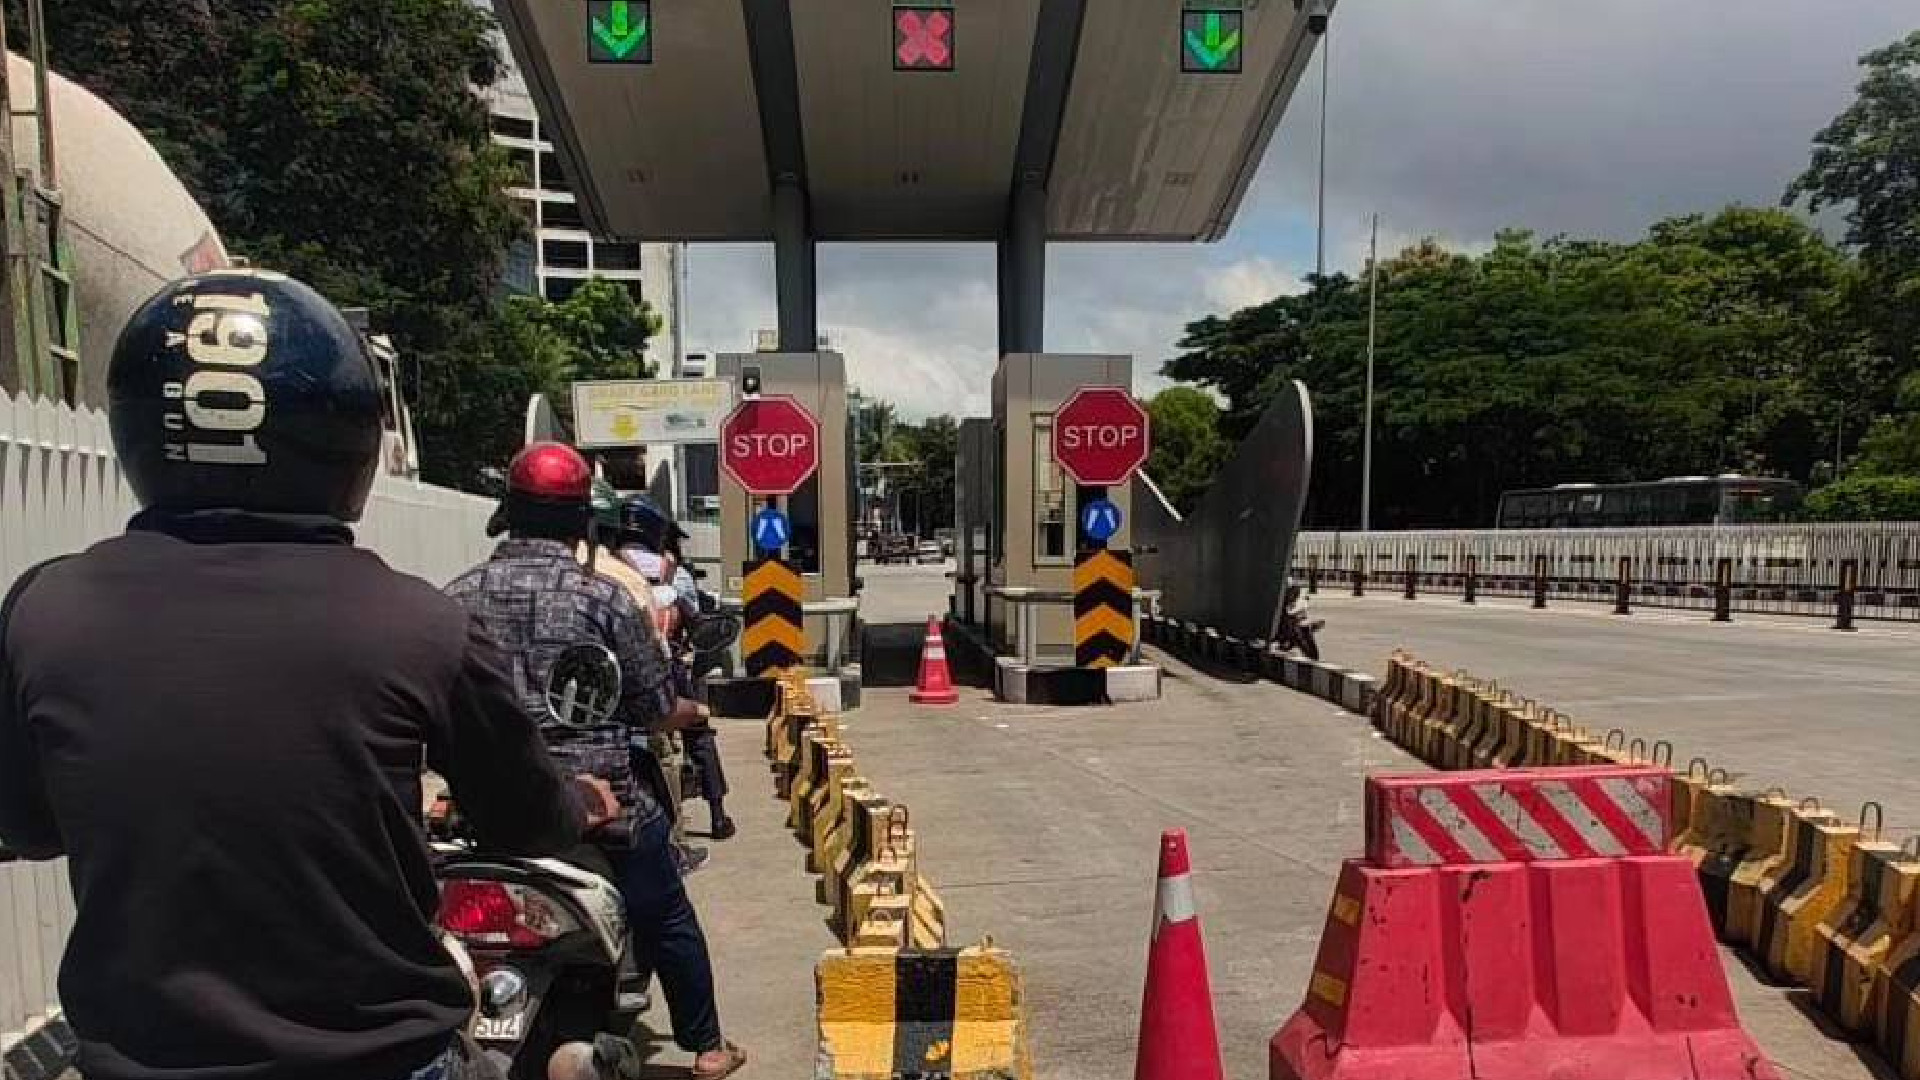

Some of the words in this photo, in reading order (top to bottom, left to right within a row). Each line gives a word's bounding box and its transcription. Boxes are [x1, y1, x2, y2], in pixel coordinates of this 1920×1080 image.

[184, 292, 270, 463] 1901
[733, 433, 809, 457] STOP
[1064, 425, 1138, 448] STOP
